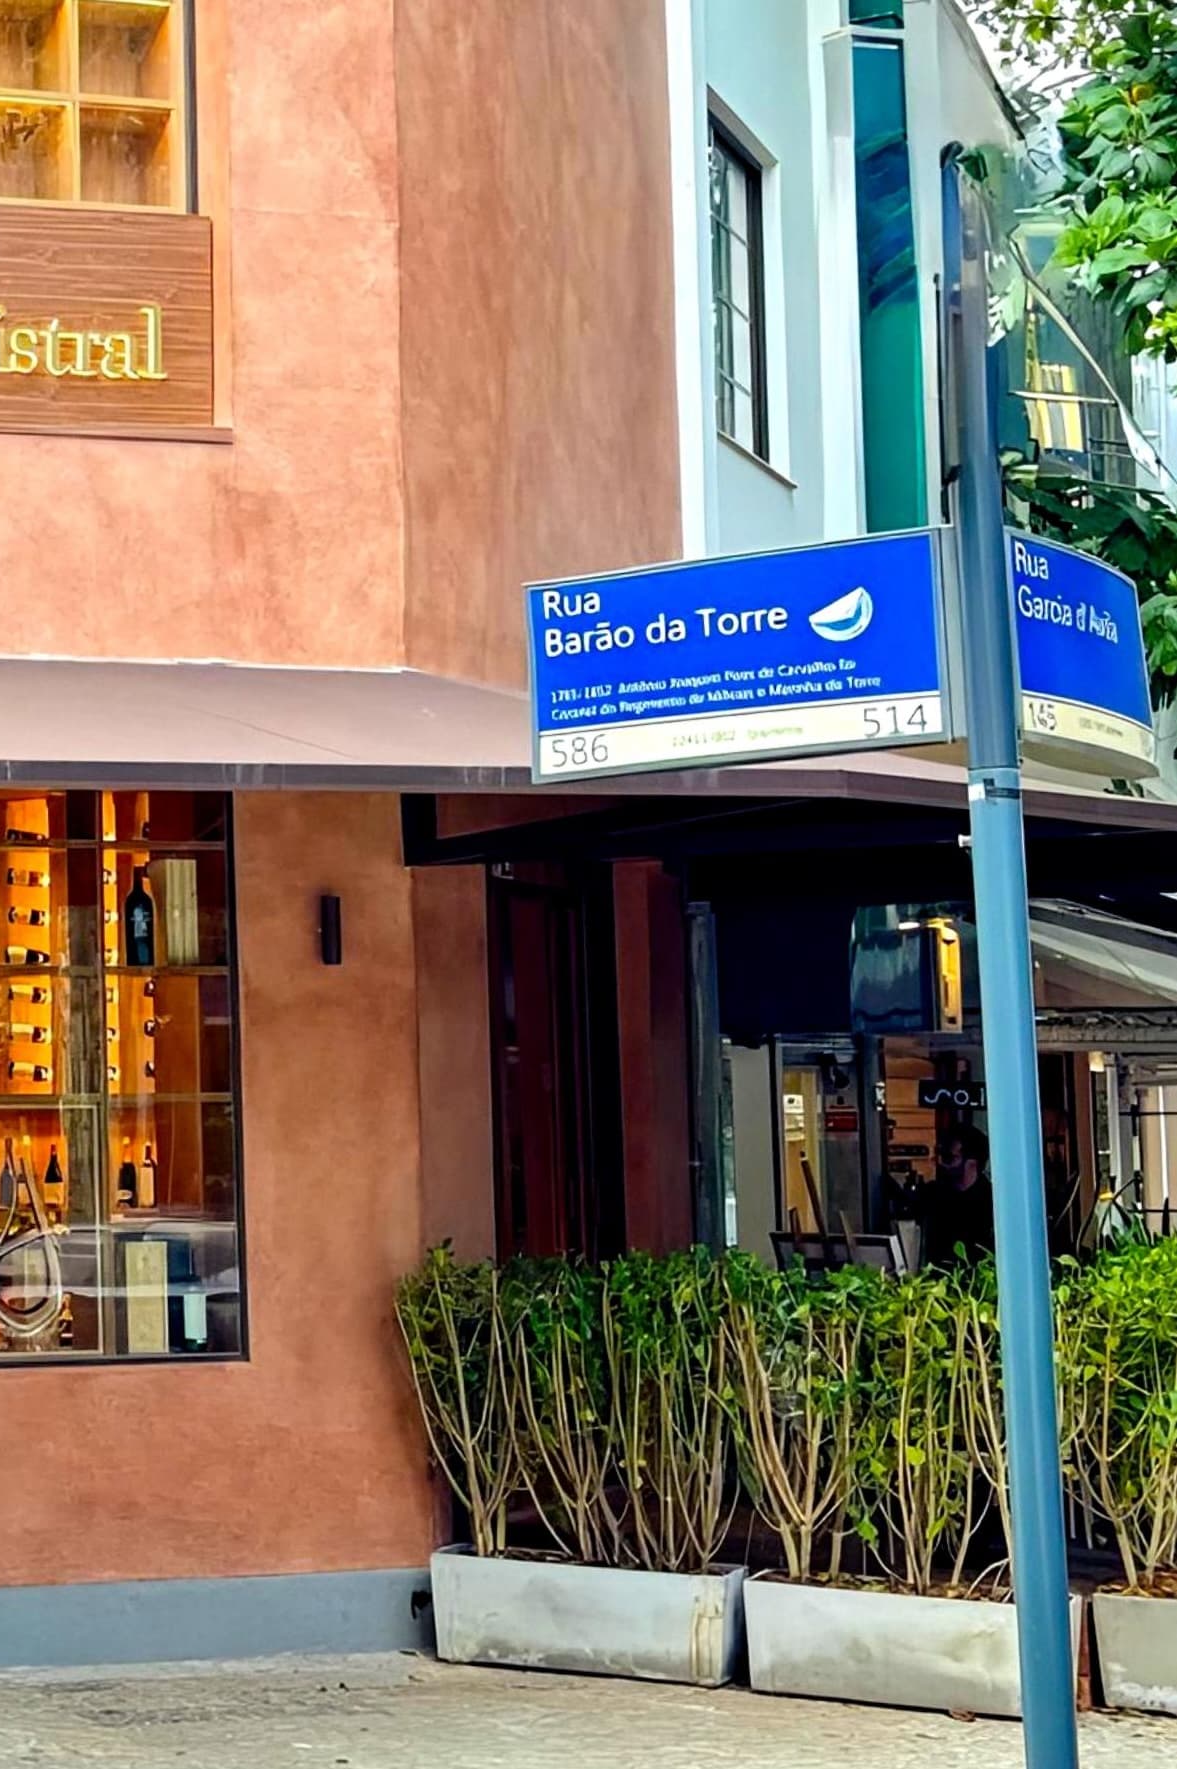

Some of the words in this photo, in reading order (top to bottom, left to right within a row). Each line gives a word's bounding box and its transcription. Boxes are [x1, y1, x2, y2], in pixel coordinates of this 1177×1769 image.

[1014, 540, 1049, 580] Rua
[542, 590, 601, 620] Rua
[544, 621, 635, 658] Barão
[645, 612, 687, 644] da
[694, 606, 789, 638] Torre
[551, 733, 609, 768] 586
[862, 703, 928, 738] 514
